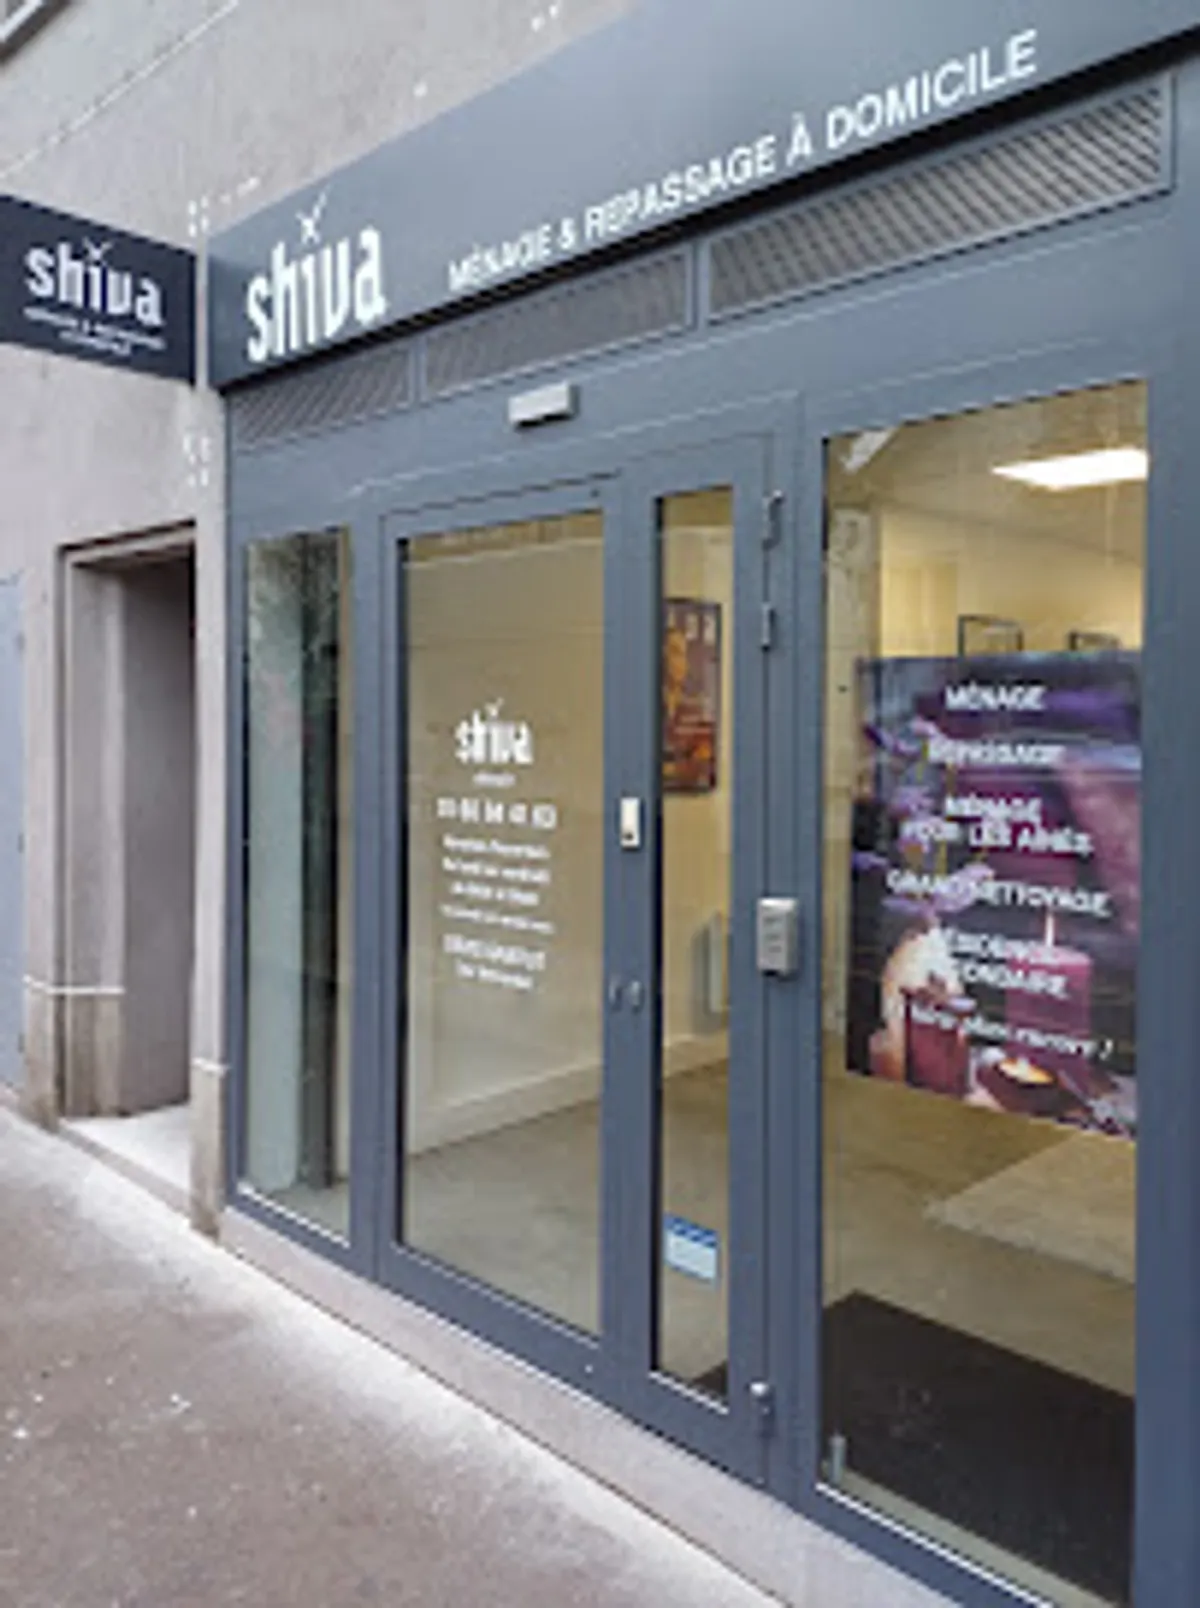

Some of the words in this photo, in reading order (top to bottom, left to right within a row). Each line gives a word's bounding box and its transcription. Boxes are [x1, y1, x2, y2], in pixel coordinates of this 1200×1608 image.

[583, 134, 778, 240] REPASSAGE
[786, 112, 813, 166] À
[825, 29, 1039, 150] DOMICILE
[24, 238, 164, 328] shiva
[246, 190, 387, 364] shiva
